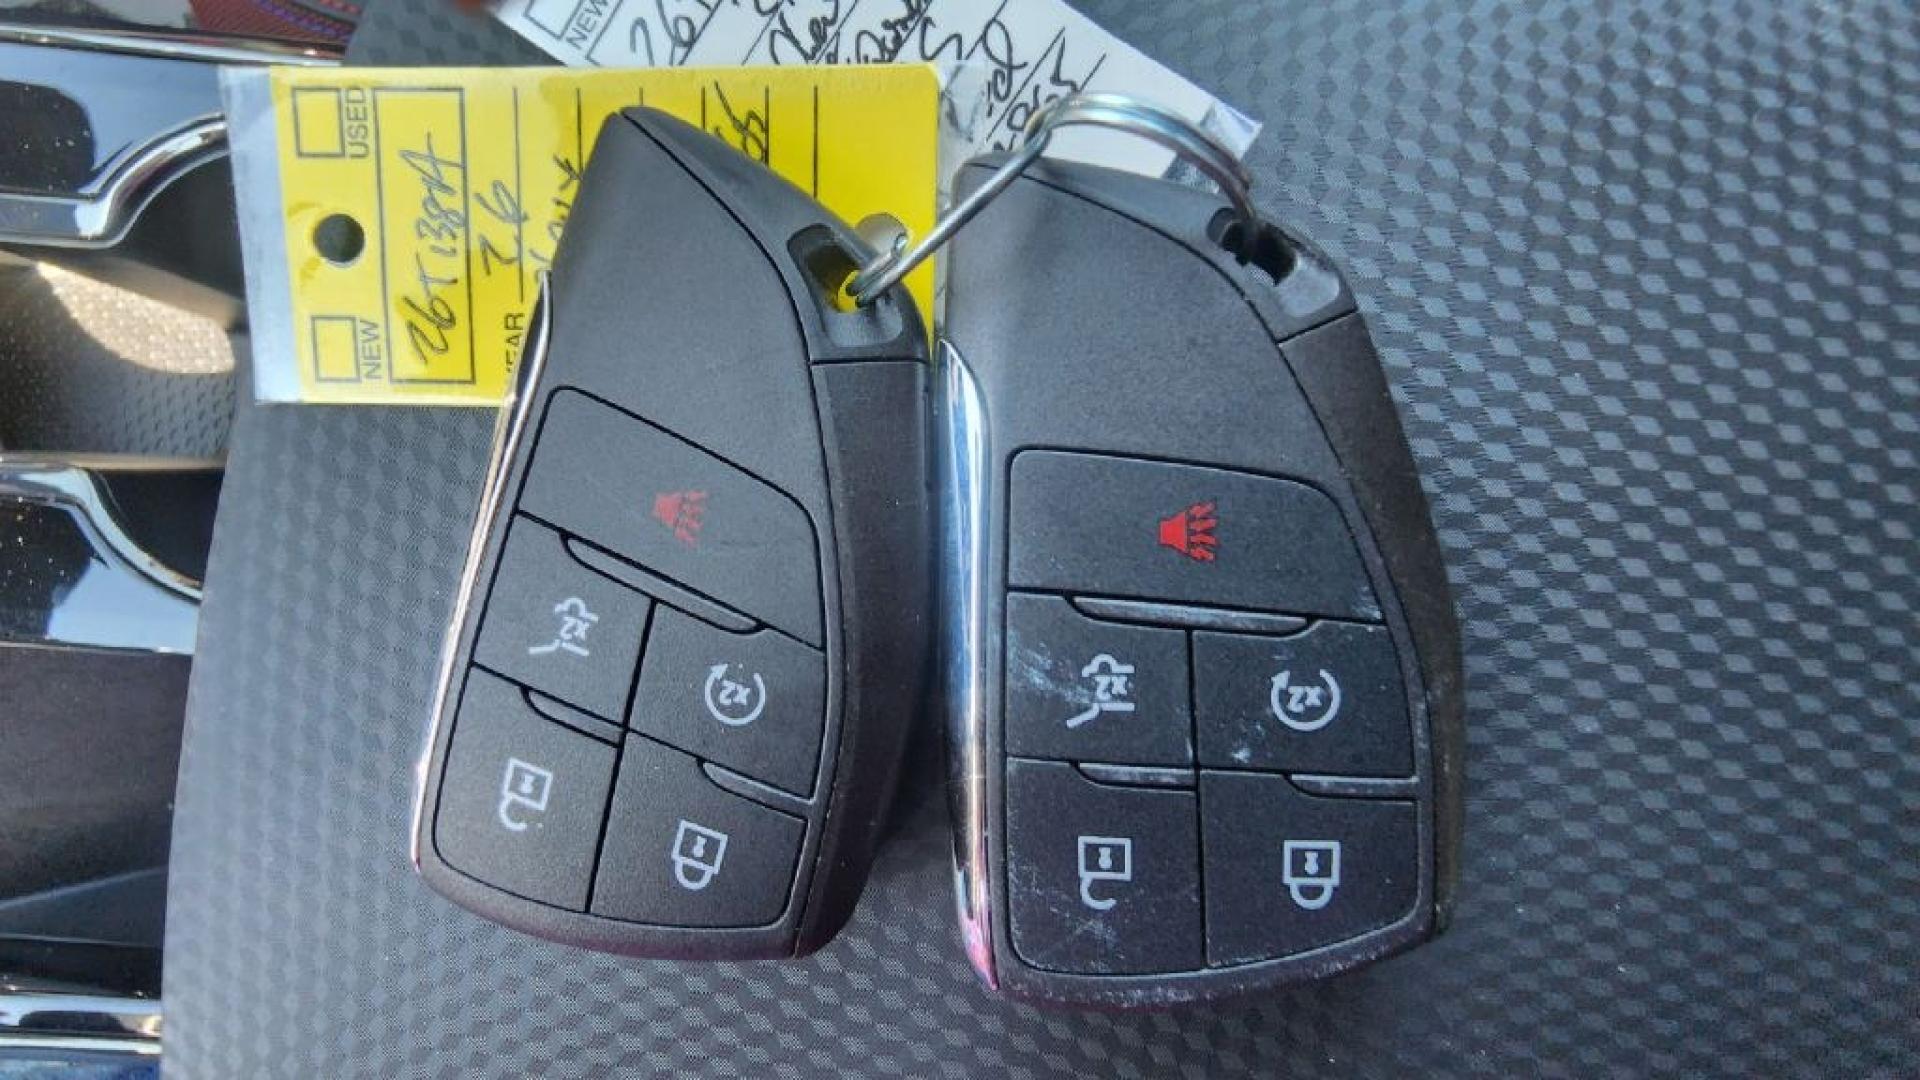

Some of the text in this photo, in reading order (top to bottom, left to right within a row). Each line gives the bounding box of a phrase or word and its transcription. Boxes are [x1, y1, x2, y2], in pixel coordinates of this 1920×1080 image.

[346, 86, 370, 158] USED
[474, 180, 529, 275] 26
[360, 319, 383, 379] NEW
[504, 312, 524, 373] EAR
